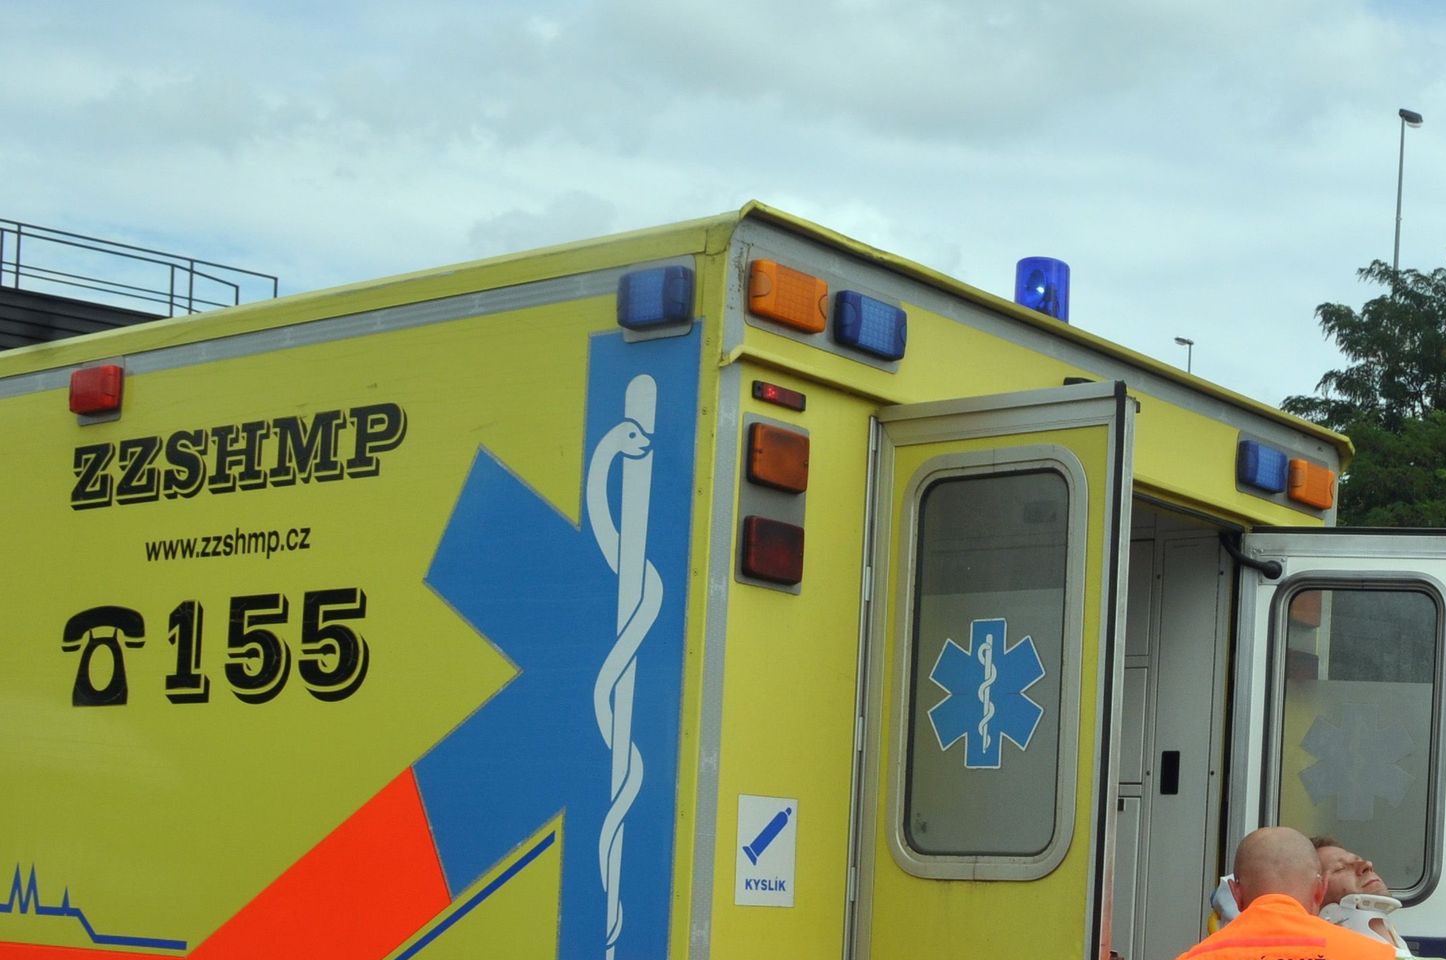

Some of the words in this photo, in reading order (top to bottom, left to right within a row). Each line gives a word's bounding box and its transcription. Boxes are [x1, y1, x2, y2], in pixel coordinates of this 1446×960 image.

[71, 402, 407, 510] ZZSHMP
[145, 527, 311, 562] www.zzshmp.cz
[165, 587, 369, 705] 155
[745, 876, 786, 892] KYSLÍK
